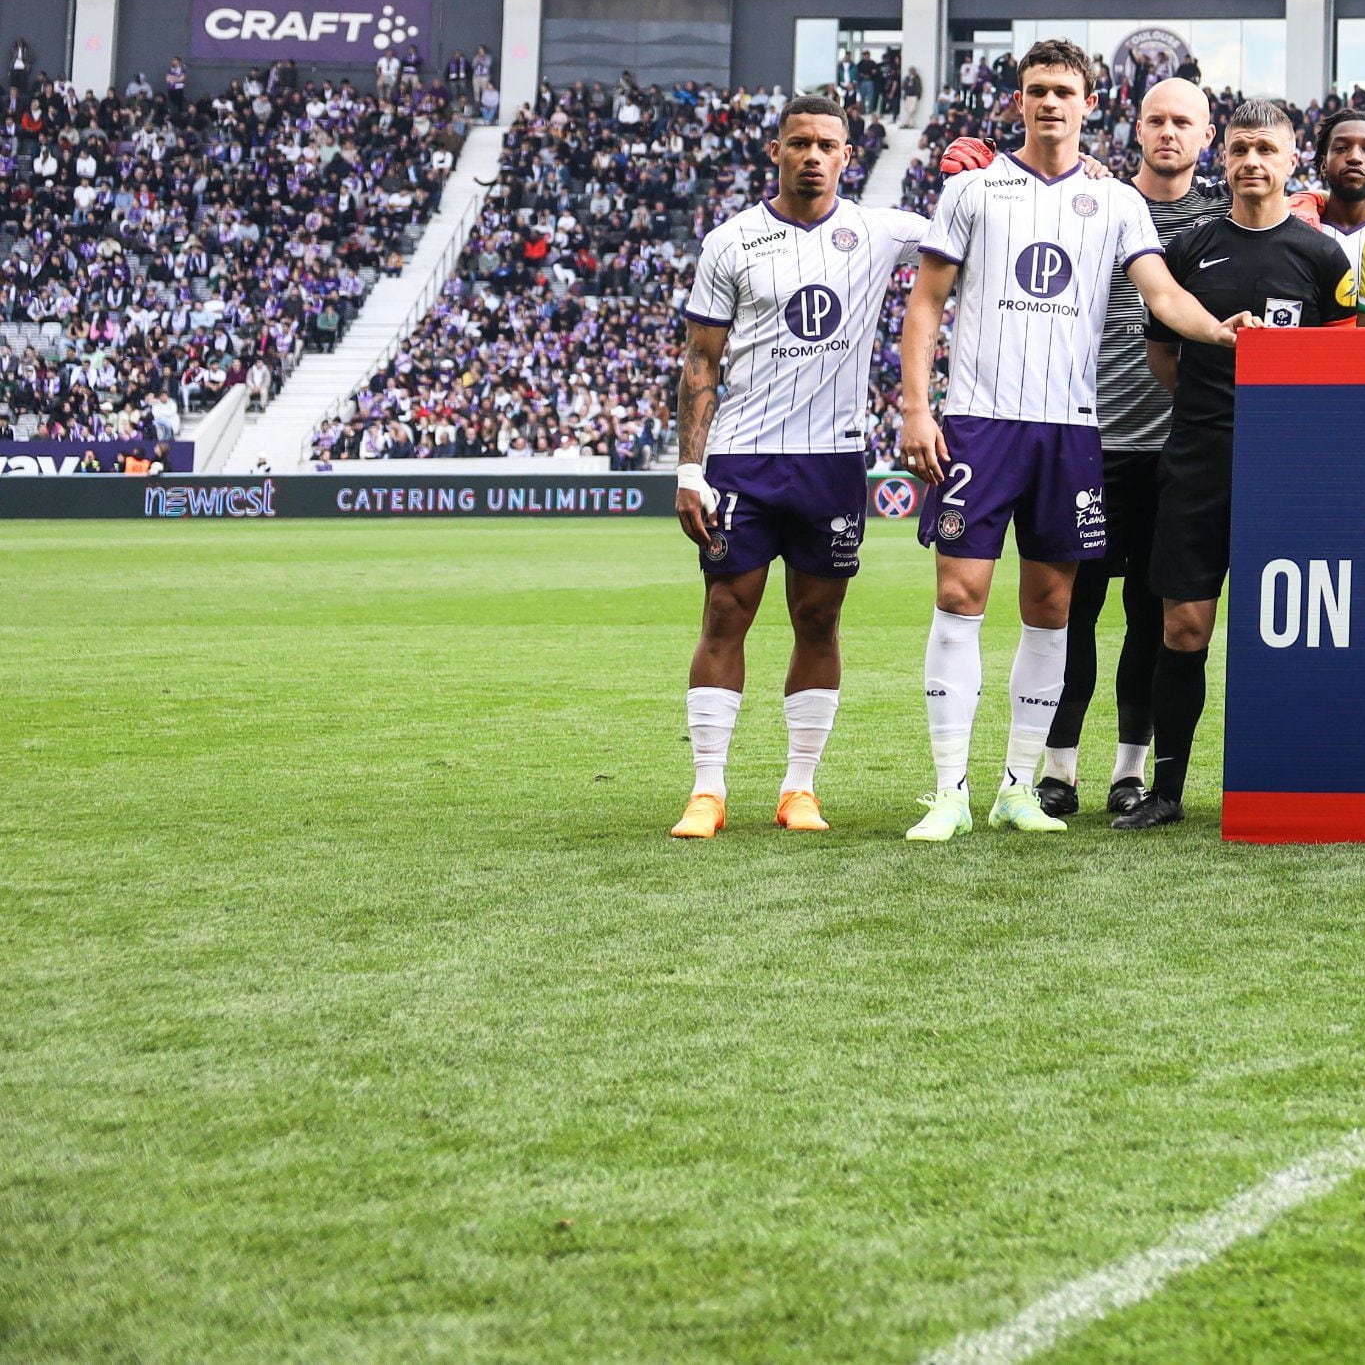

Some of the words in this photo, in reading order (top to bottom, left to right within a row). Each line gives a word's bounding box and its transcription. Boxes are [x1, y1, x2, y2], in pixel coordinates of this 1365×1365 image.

[205, 8, 373, 42] CRAFT
[984, 177, 1028, 188] betway
[742, 229, 787, 251] betway
[998, 299, 1080, 318] PROMOTION
[942, 462, 973, 507] 2
[1088, 487, 1103, 504] Sud
[145, 480, 275, 516] newrest
[336, 487, 475, 512] CATERING
[486, 487, 645, 512] UNLIMITED
[1259, 559, 1352, 648] ON
